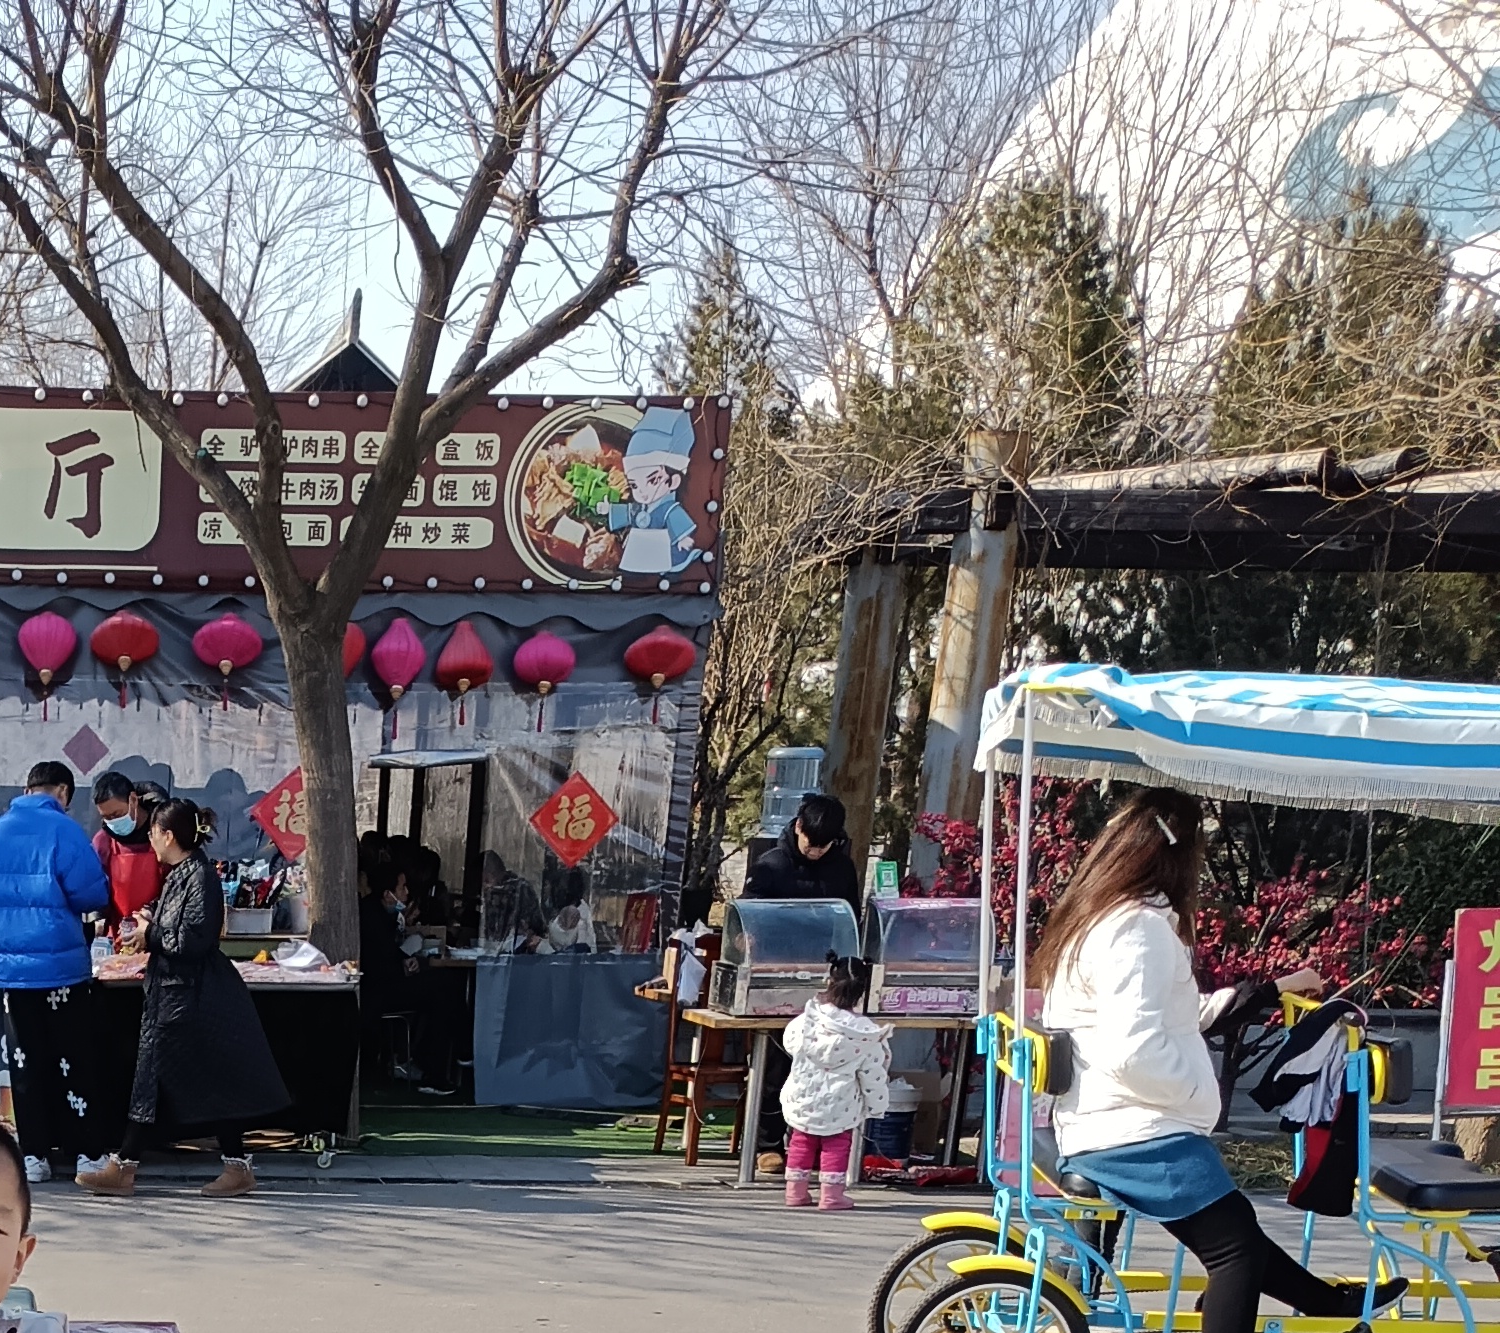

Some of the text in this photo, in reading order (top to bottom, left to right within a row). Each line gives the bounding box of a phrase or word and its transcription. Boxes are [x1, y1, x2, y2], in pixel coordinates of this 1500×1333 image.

[441, 438, 495, 461] 盒饭
[438, 479, 492, 502] 馄饨
[392, 521, 471, 545] 种炒菜
[272, 788, 309, 836] 福
[551, 793, 596, 841] 福
